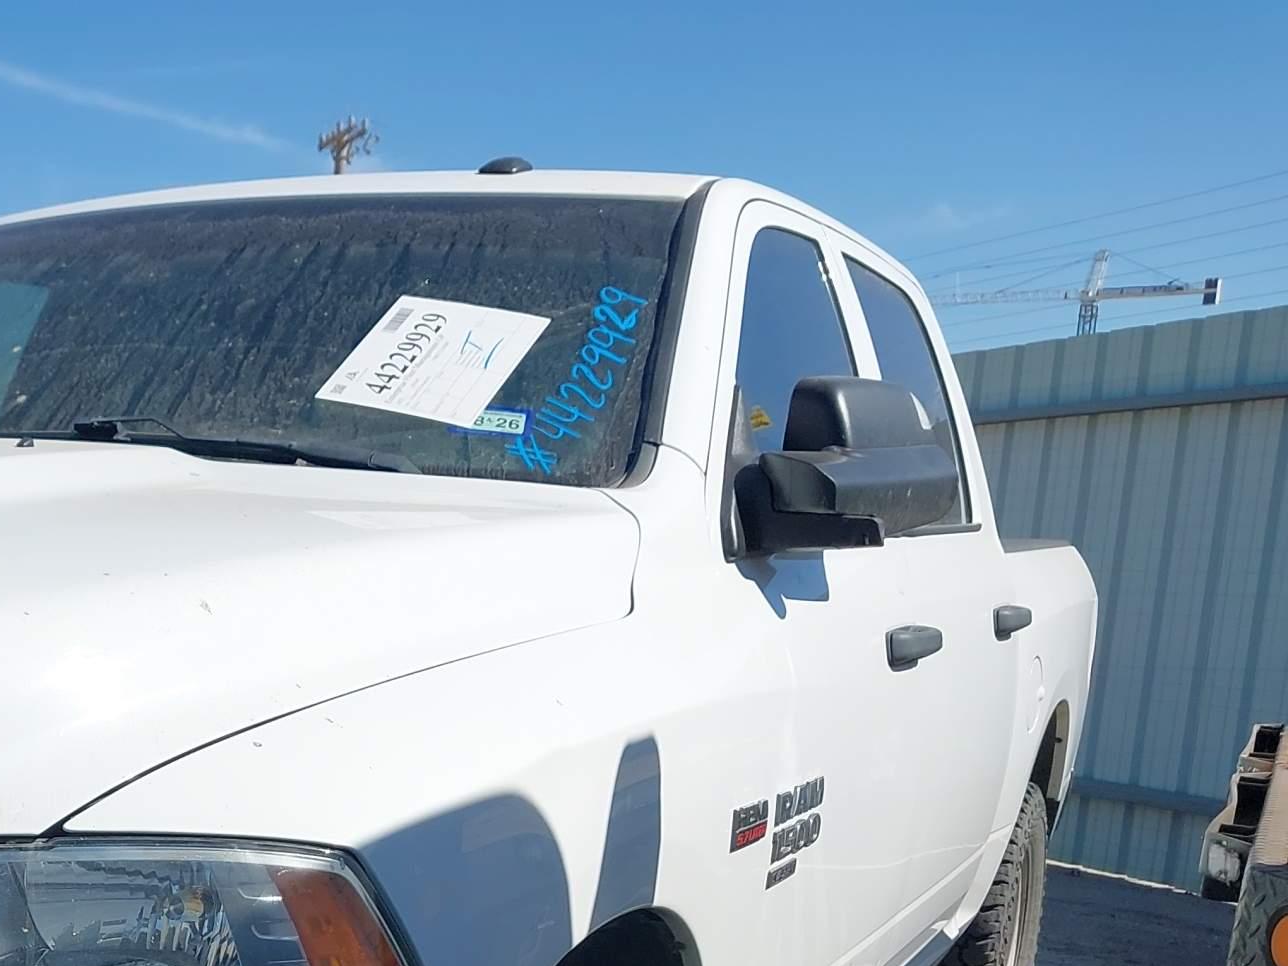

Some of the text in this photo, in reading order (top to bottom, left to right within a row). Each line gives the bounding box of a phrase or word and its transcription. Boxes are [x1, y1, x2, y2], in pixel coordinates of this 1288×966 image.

[365, 313, 448, 395] 44229929
[496, 417, 520, 430] 26
[774, 776, 824, 828] RAM
[770, 812, 822, 866] 1500
